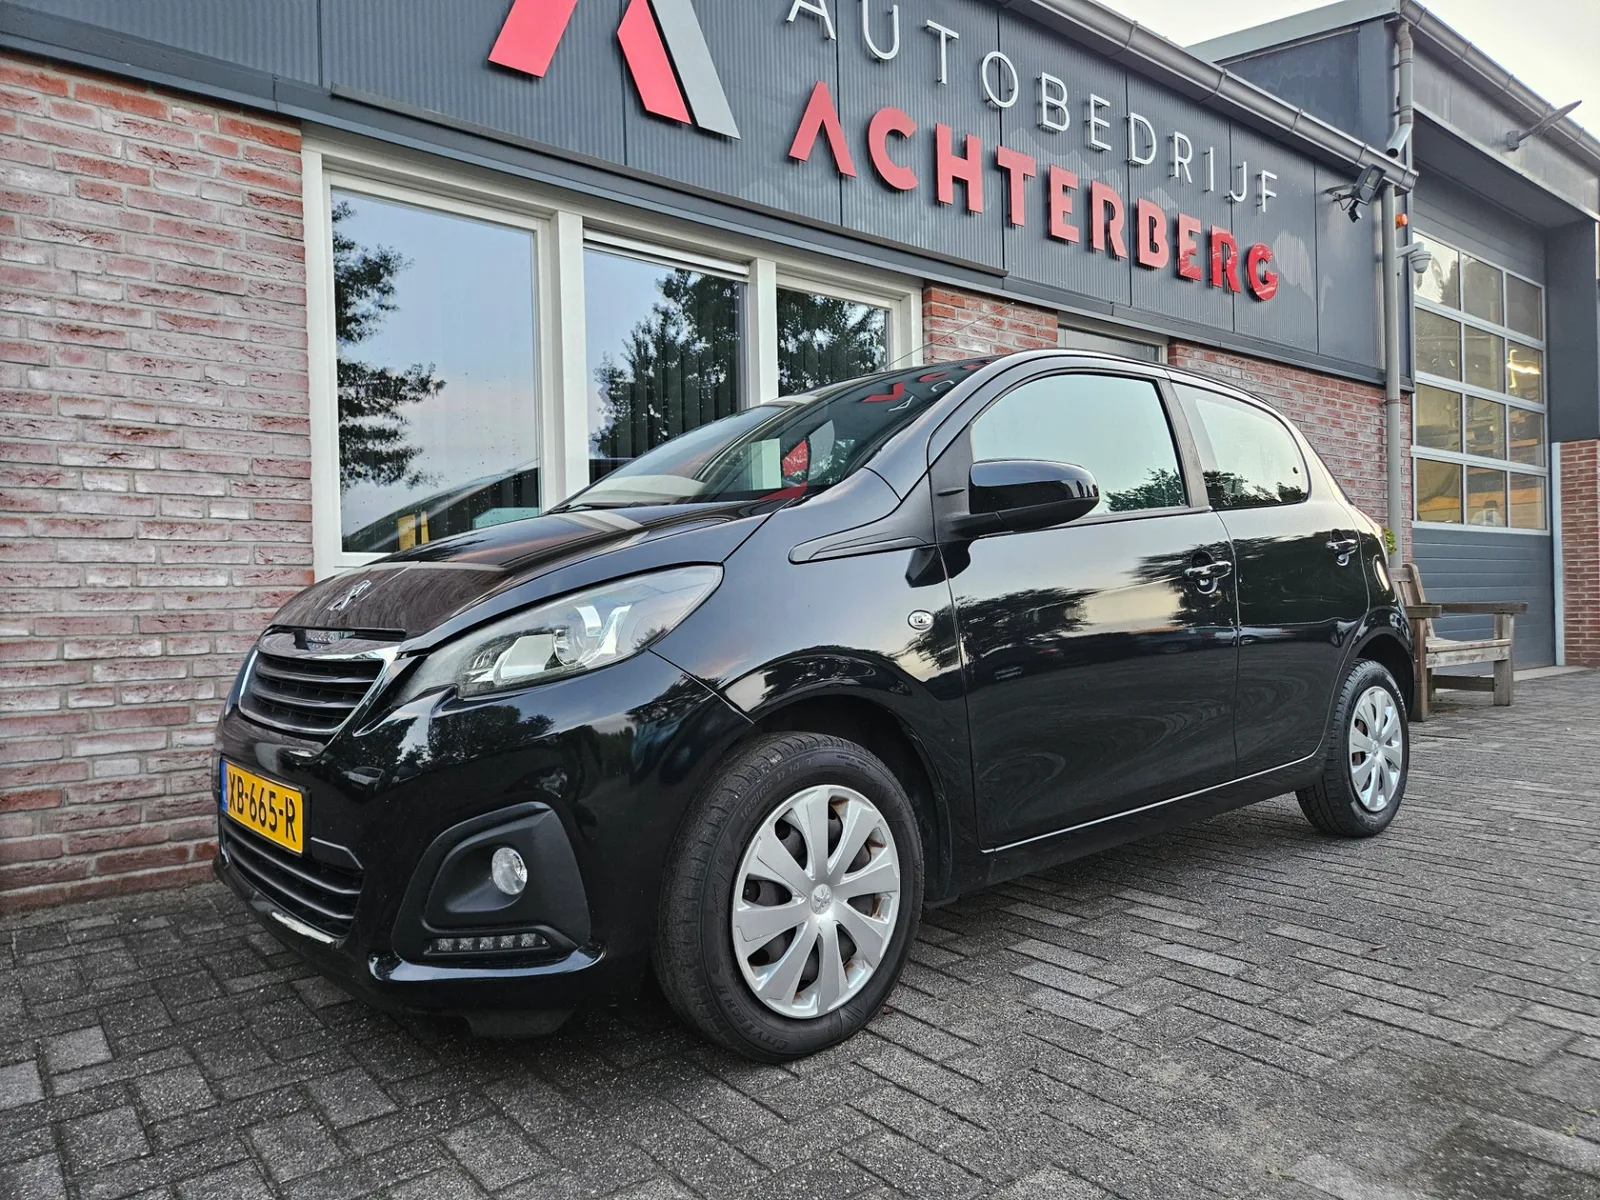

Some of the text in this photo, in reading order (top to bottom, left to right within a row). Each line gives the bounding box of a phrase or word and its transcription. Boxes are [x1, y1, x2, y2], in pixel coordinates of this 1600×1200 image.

[786, 0, 1278, 213] AUTOBEDRIJF
[788, 80, 1279, 301] ACHTERBERG
[228, 771, 297, 843] XB-665-R
